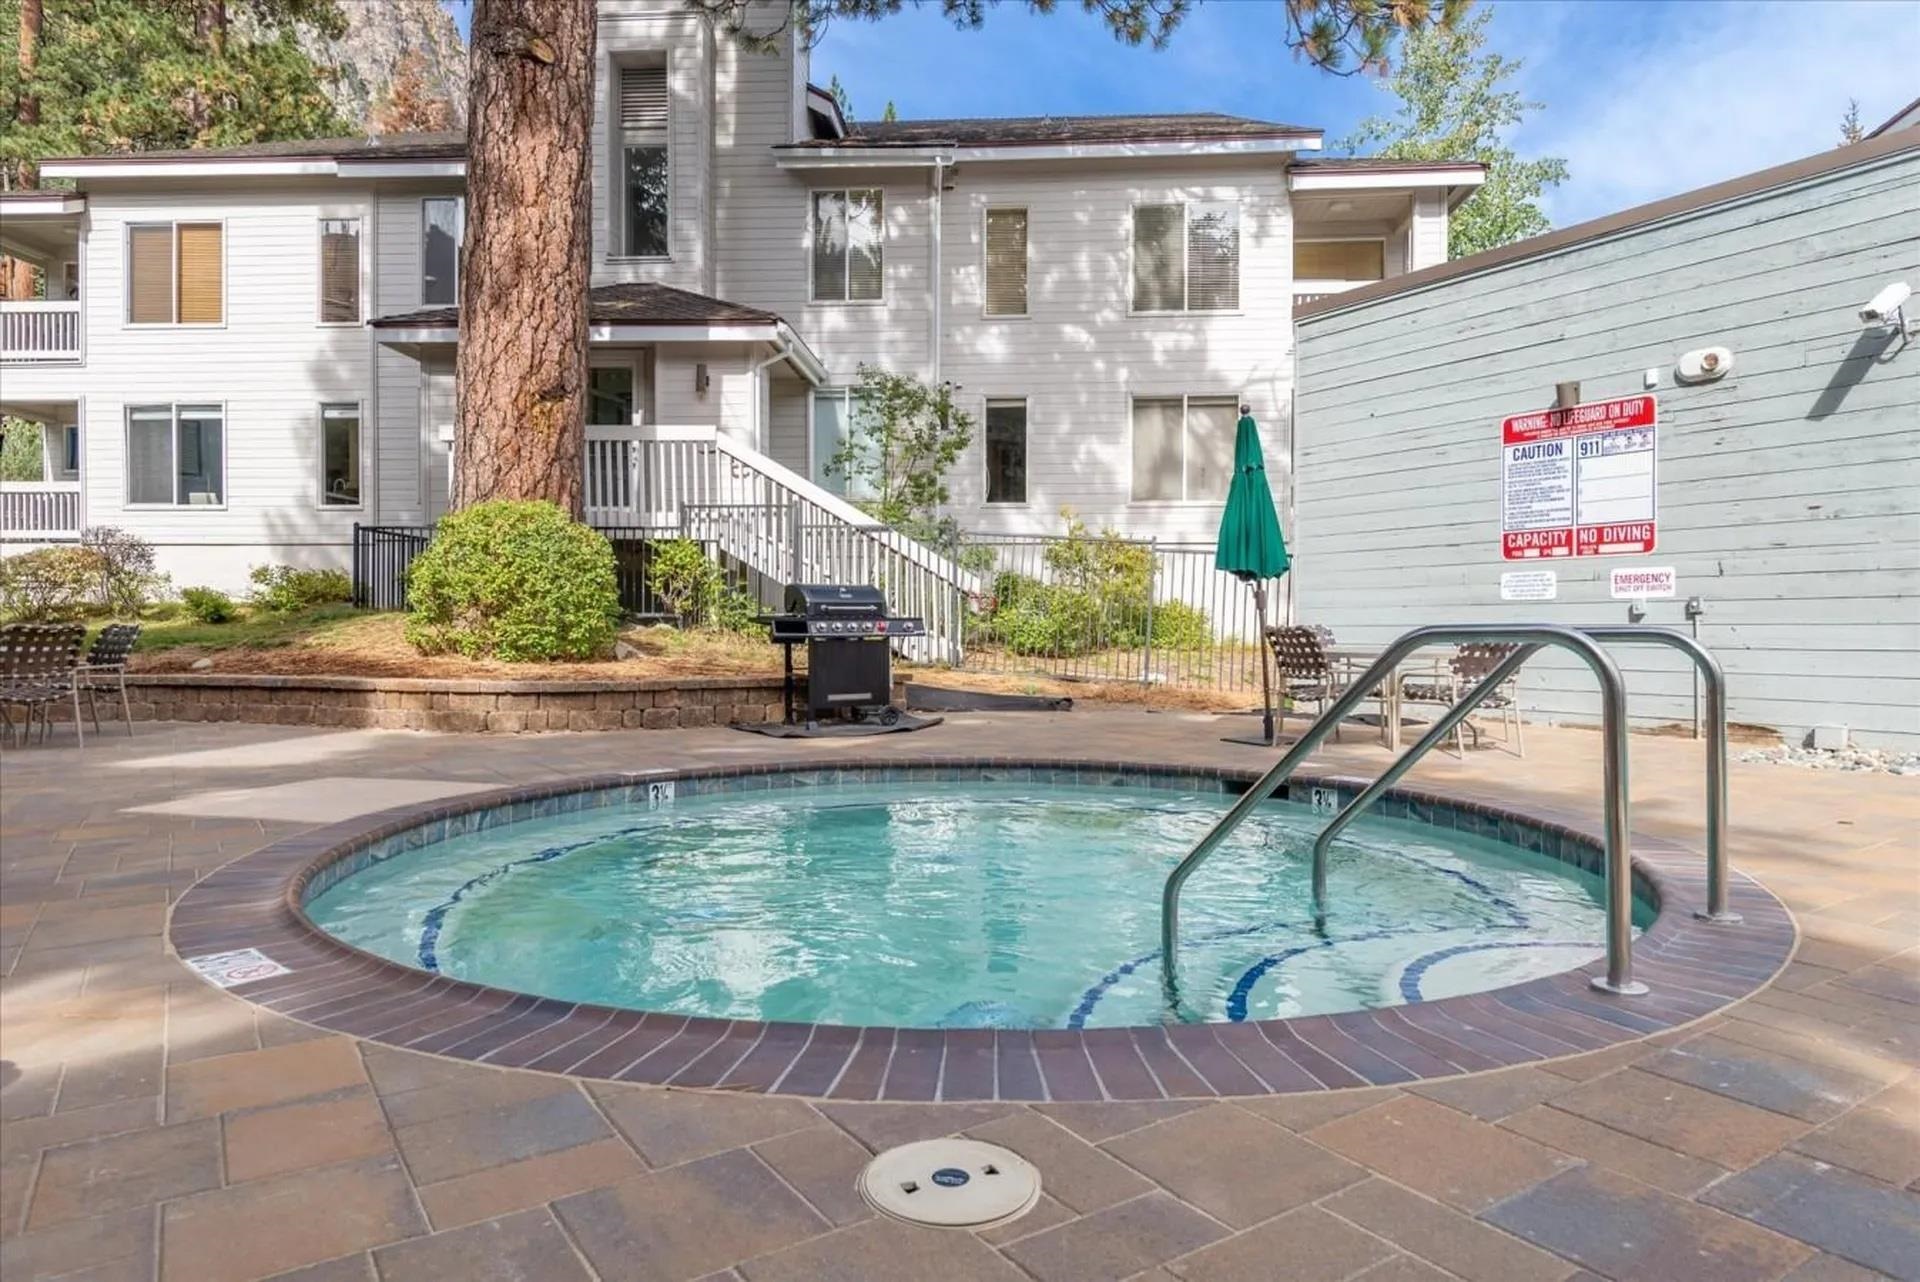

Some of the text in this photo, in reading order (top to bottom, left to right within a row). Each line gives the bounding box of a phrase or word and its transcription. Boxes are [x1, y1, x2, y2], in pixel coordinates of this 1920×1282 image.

[1563, 405, 1606, 426] LIFEGUARD
[1608, 403, 1620, 419] ON
[1623, 400, 1644, 416] DUTY
[1513, 442, 1562, 461] CAUTION
[1580, 440, 1599, 456] 911
[1507, 531, 1567, 548] CAPACITY
[1580, 525, 1651, 544] NO DIVING
[1614, 573, 1671, 585] EMERGENCY
[1646, 583, 1672, 592] SWITCH
